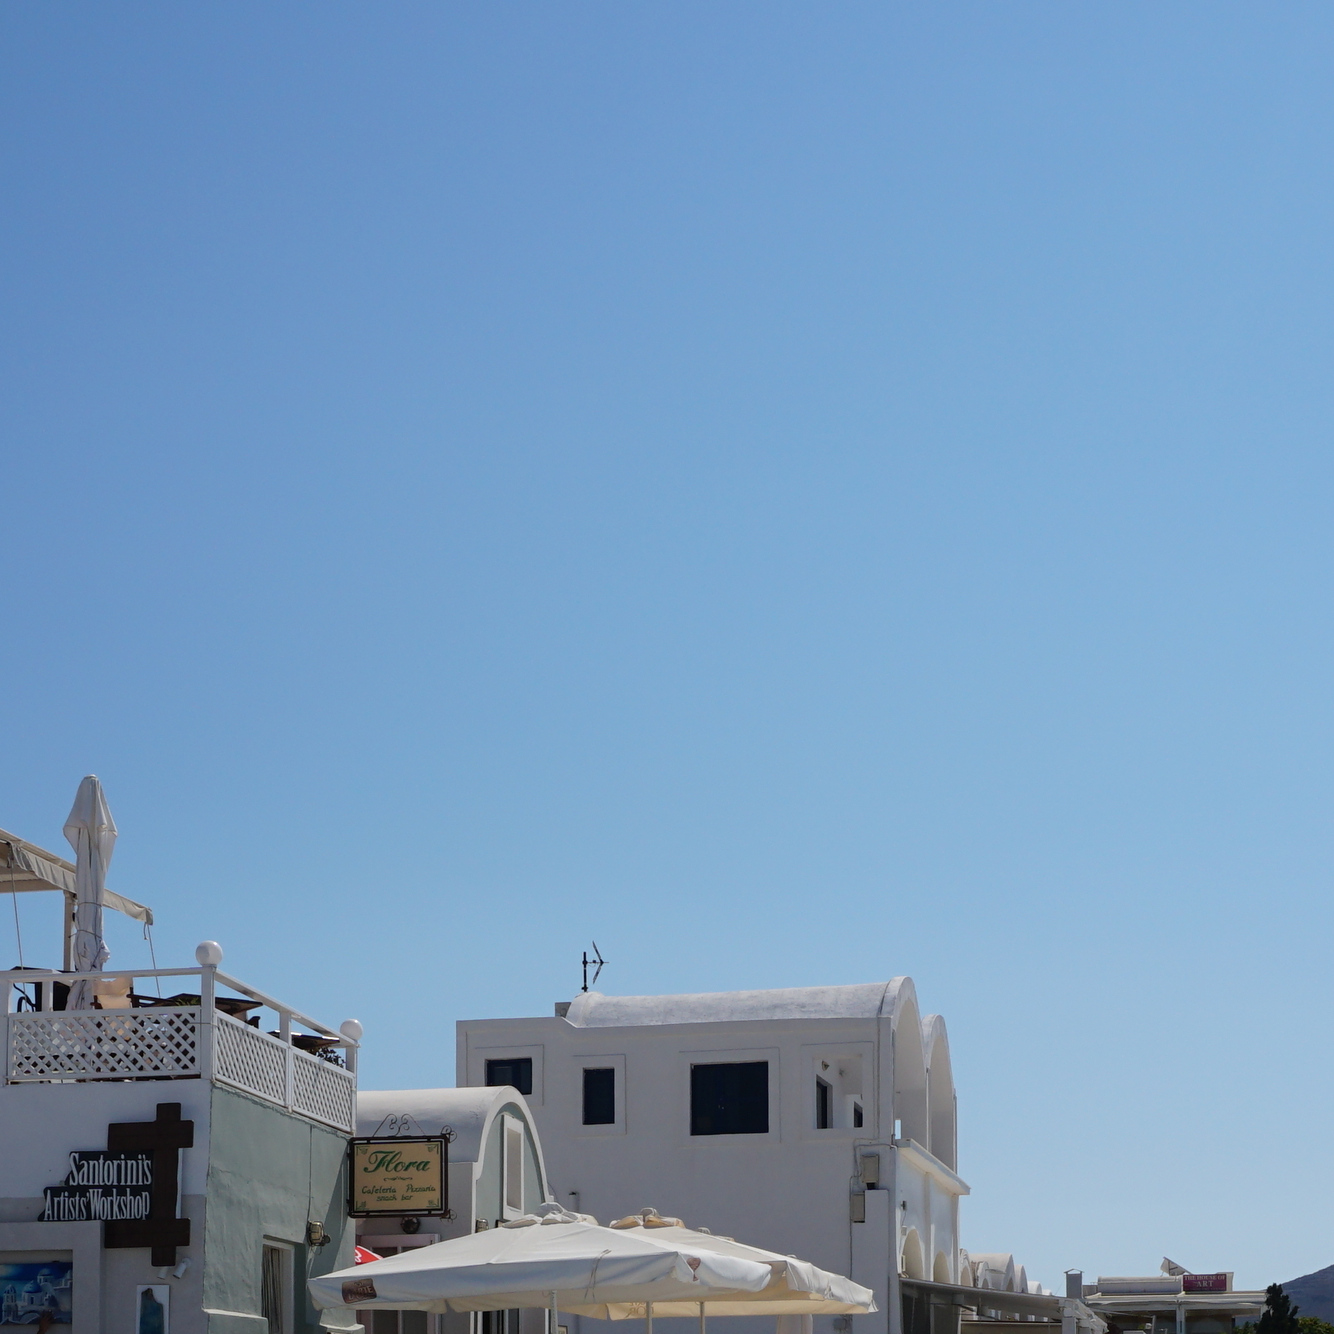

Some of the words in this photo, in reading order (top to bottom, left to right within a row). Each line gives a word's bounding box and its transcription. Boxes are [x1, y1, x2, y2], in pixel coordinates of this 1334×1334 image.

[69, 1152, 153, 1186] Santorini's
[363, 1150, 431, 1173] Flora
[361, 1185, 397, 1195] Cafeteria
[376, 1194, 397, 1202] snack
[400, 1193, 414, 1202] bar
[44, 1189, 90, 1221] Artists'
[89, 1187, 150, 1221] Workshop
